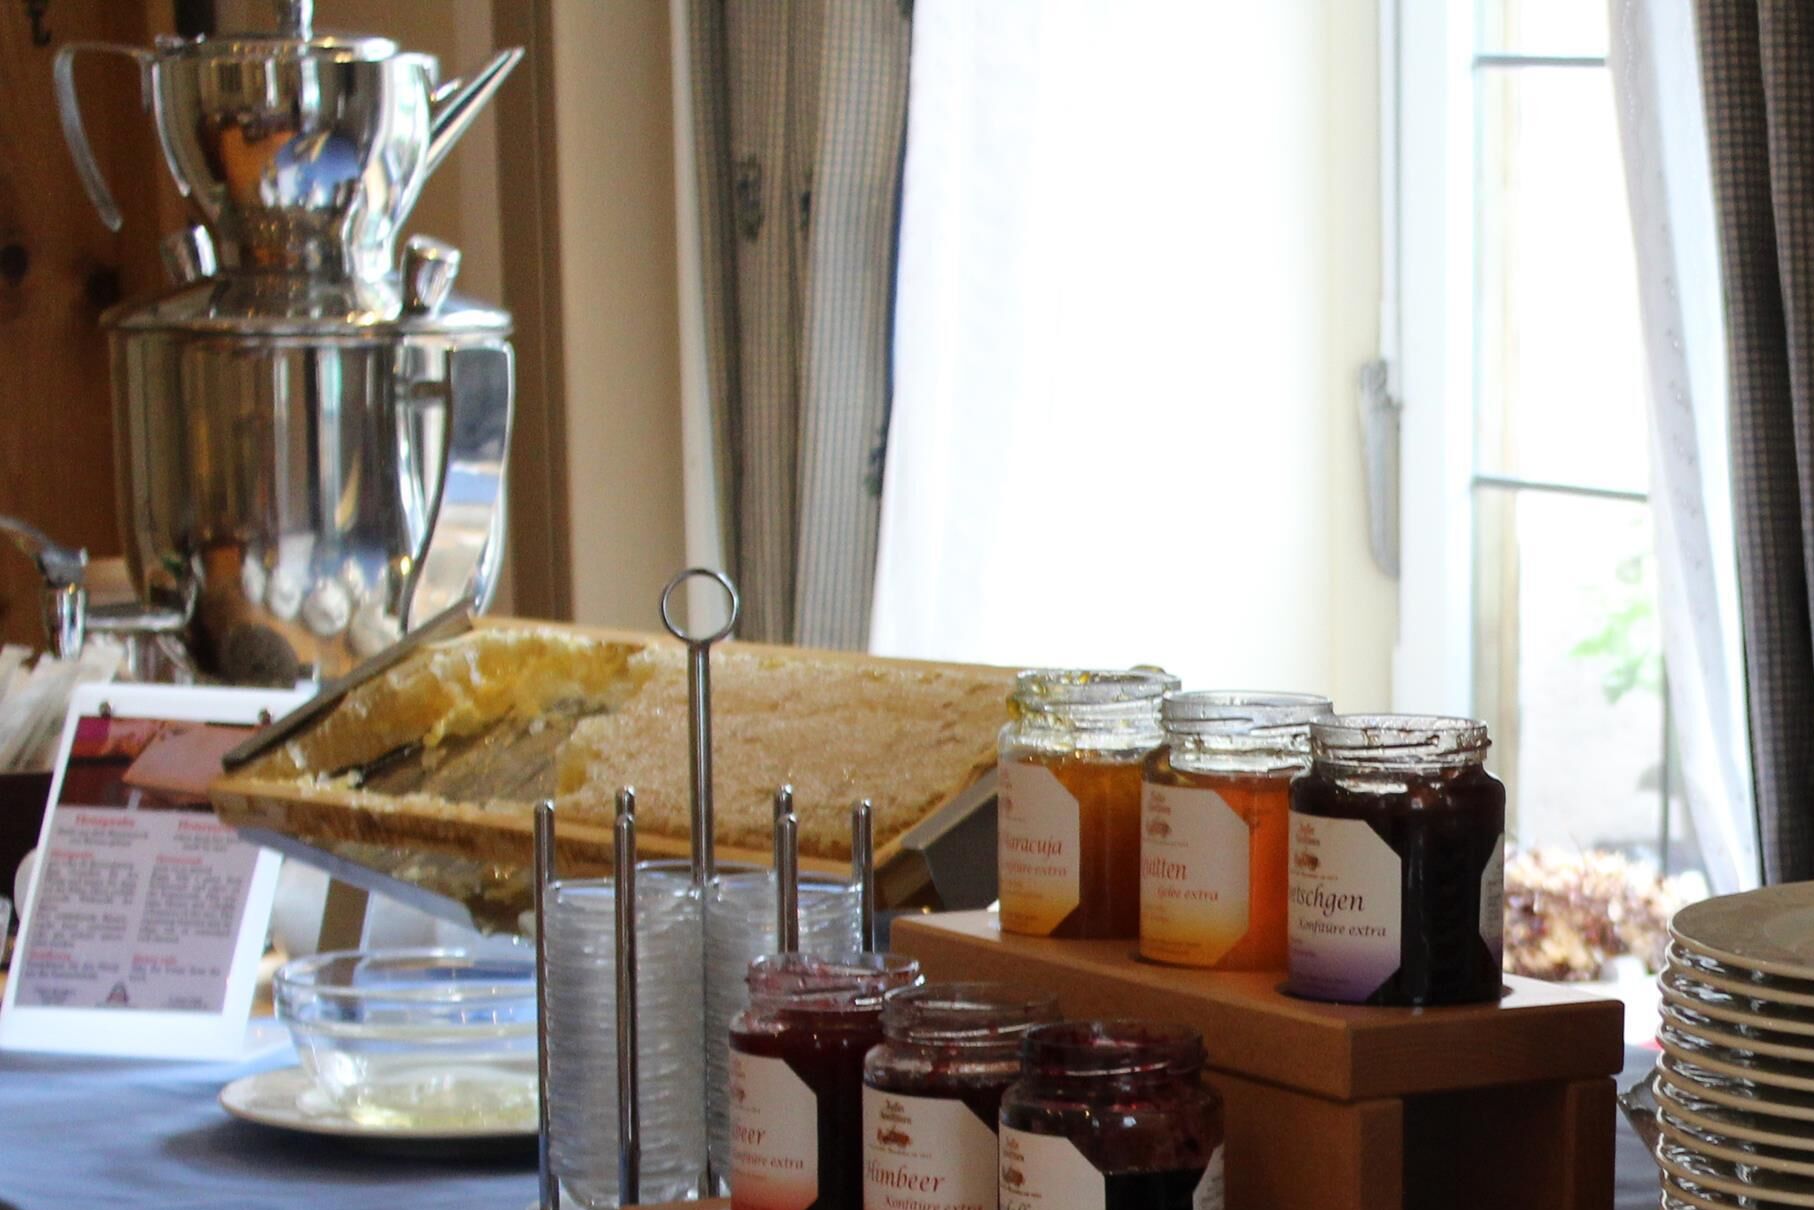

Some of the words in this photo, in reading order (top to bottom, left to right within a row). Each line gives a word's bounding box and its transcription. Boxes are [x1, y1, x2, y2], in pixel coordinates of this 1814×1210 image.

[1184, 888, 1219, 901] extra
[1290, 883, 1365, 917] etschgen
[1348, 924, 1387, 938] extra
[734, 1117, 767, 1145] beer
[770, 1156, 804, 1170] extra
